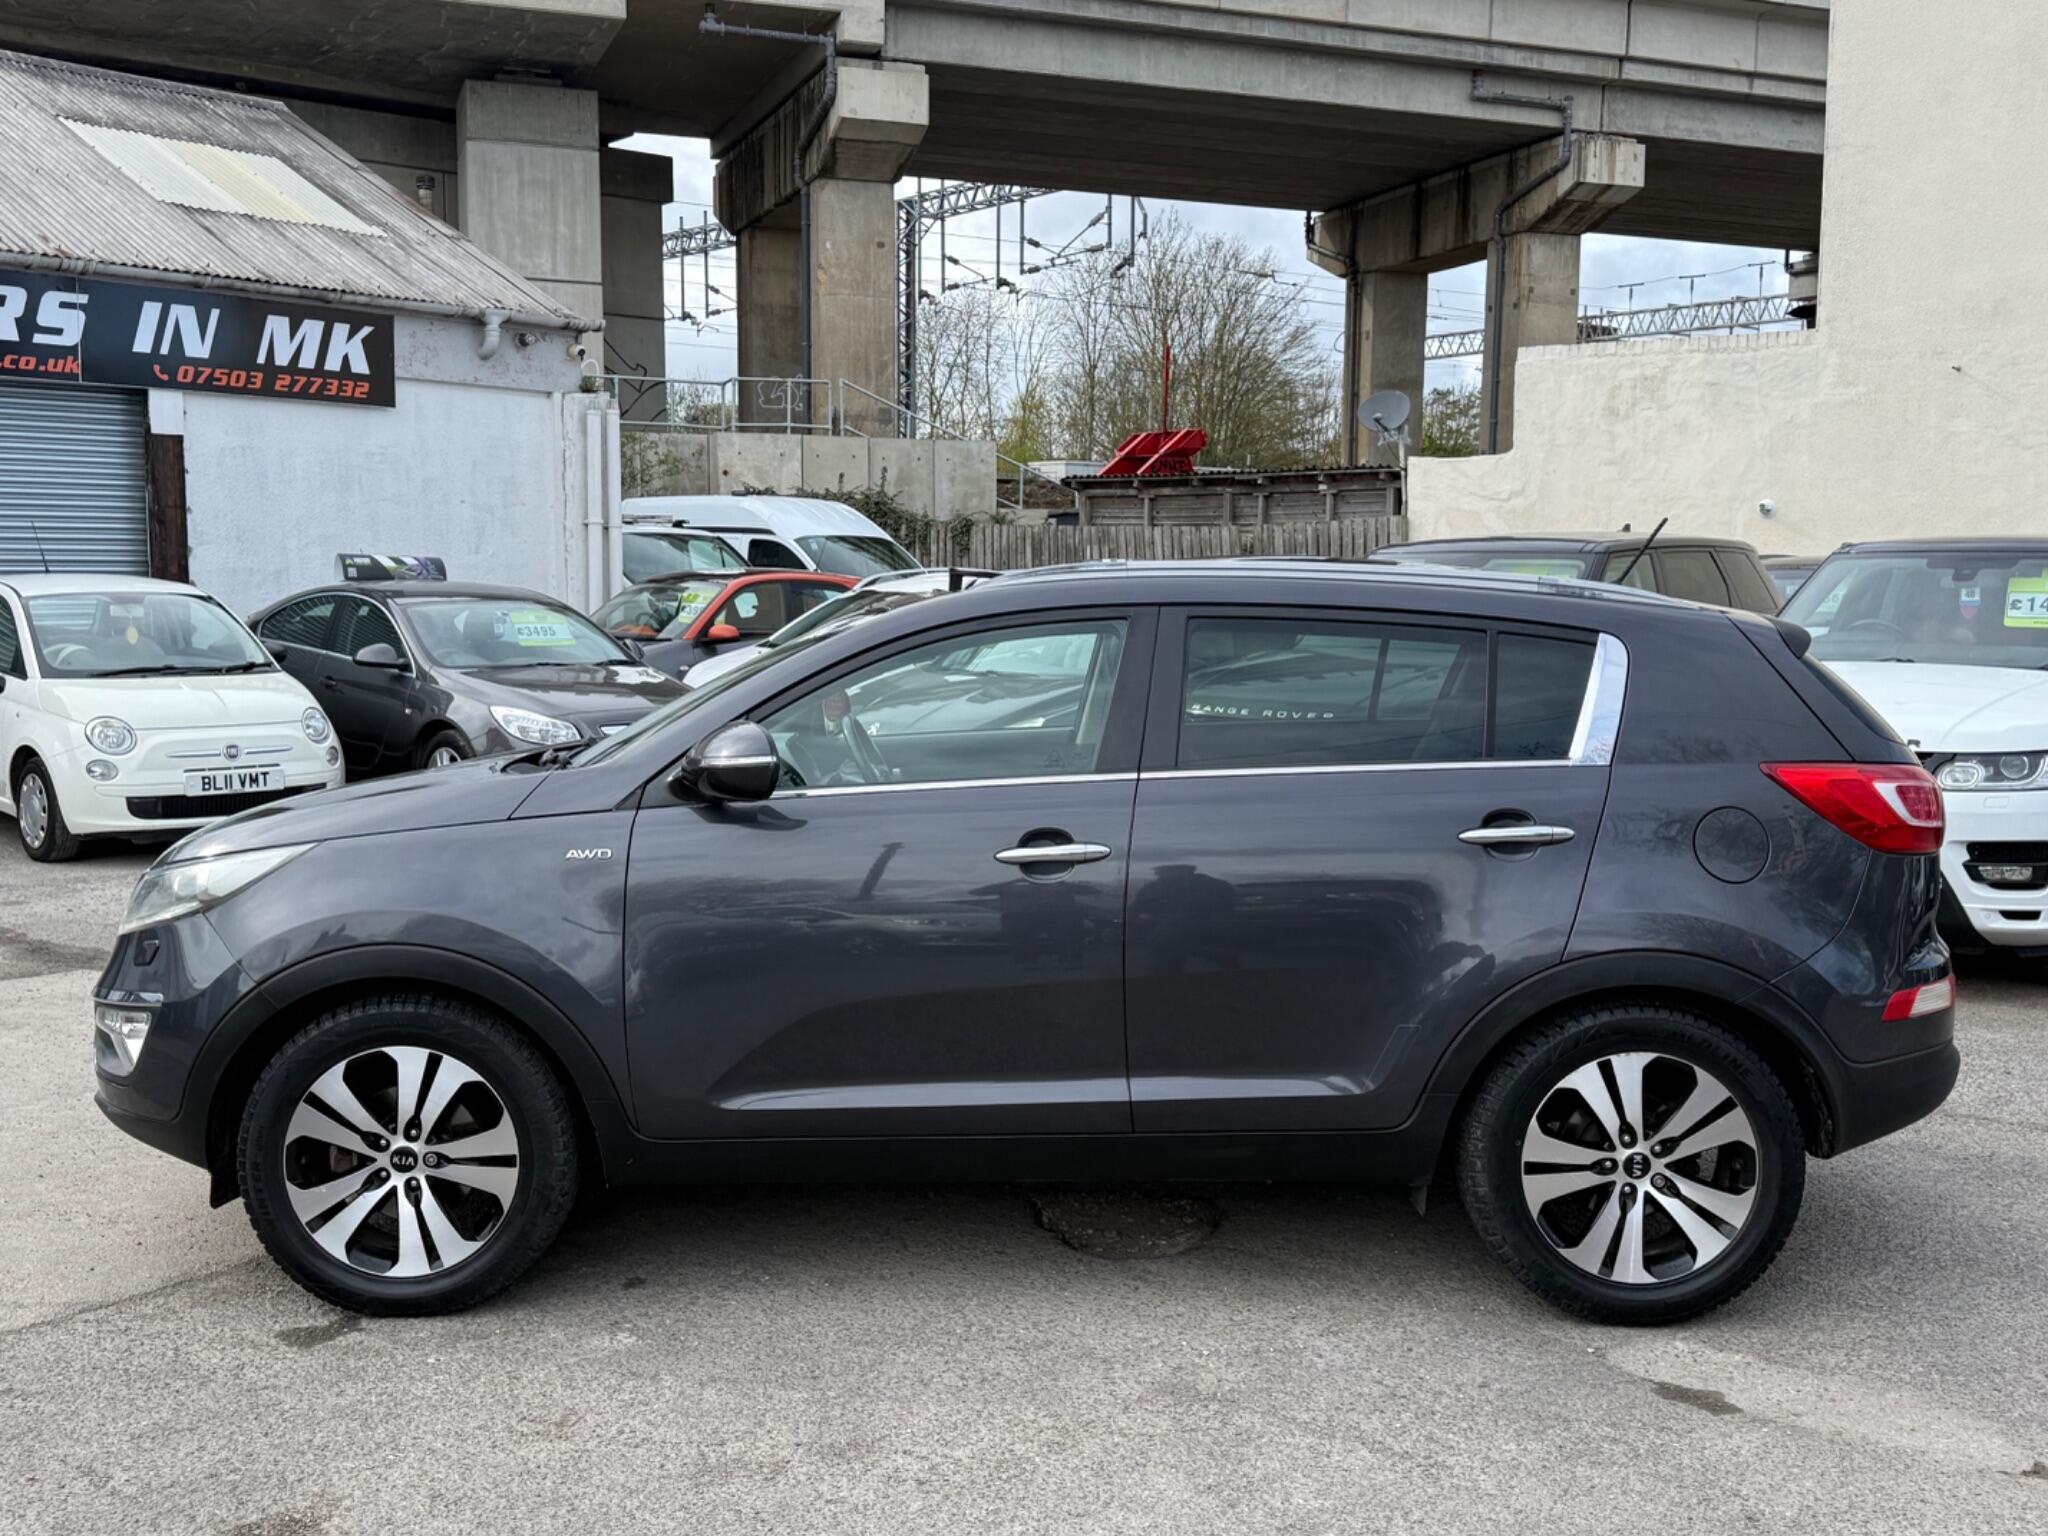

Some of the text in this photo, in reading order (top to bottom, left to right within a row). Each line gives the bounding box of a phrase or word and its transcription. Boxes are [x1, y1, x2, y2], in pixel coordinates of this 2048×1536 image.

[132, 301, 220, 359] IN
[256, 314, 375, 375] MK
[176, 365, 370, 398] 07503 277332
[201, 771, 269, 791] BL11 VMT
[566, 848, 611, 859] AWD
[392, 1154, 415, 1166] KIA
[1632, 1154, 1643, 1177] KIA
